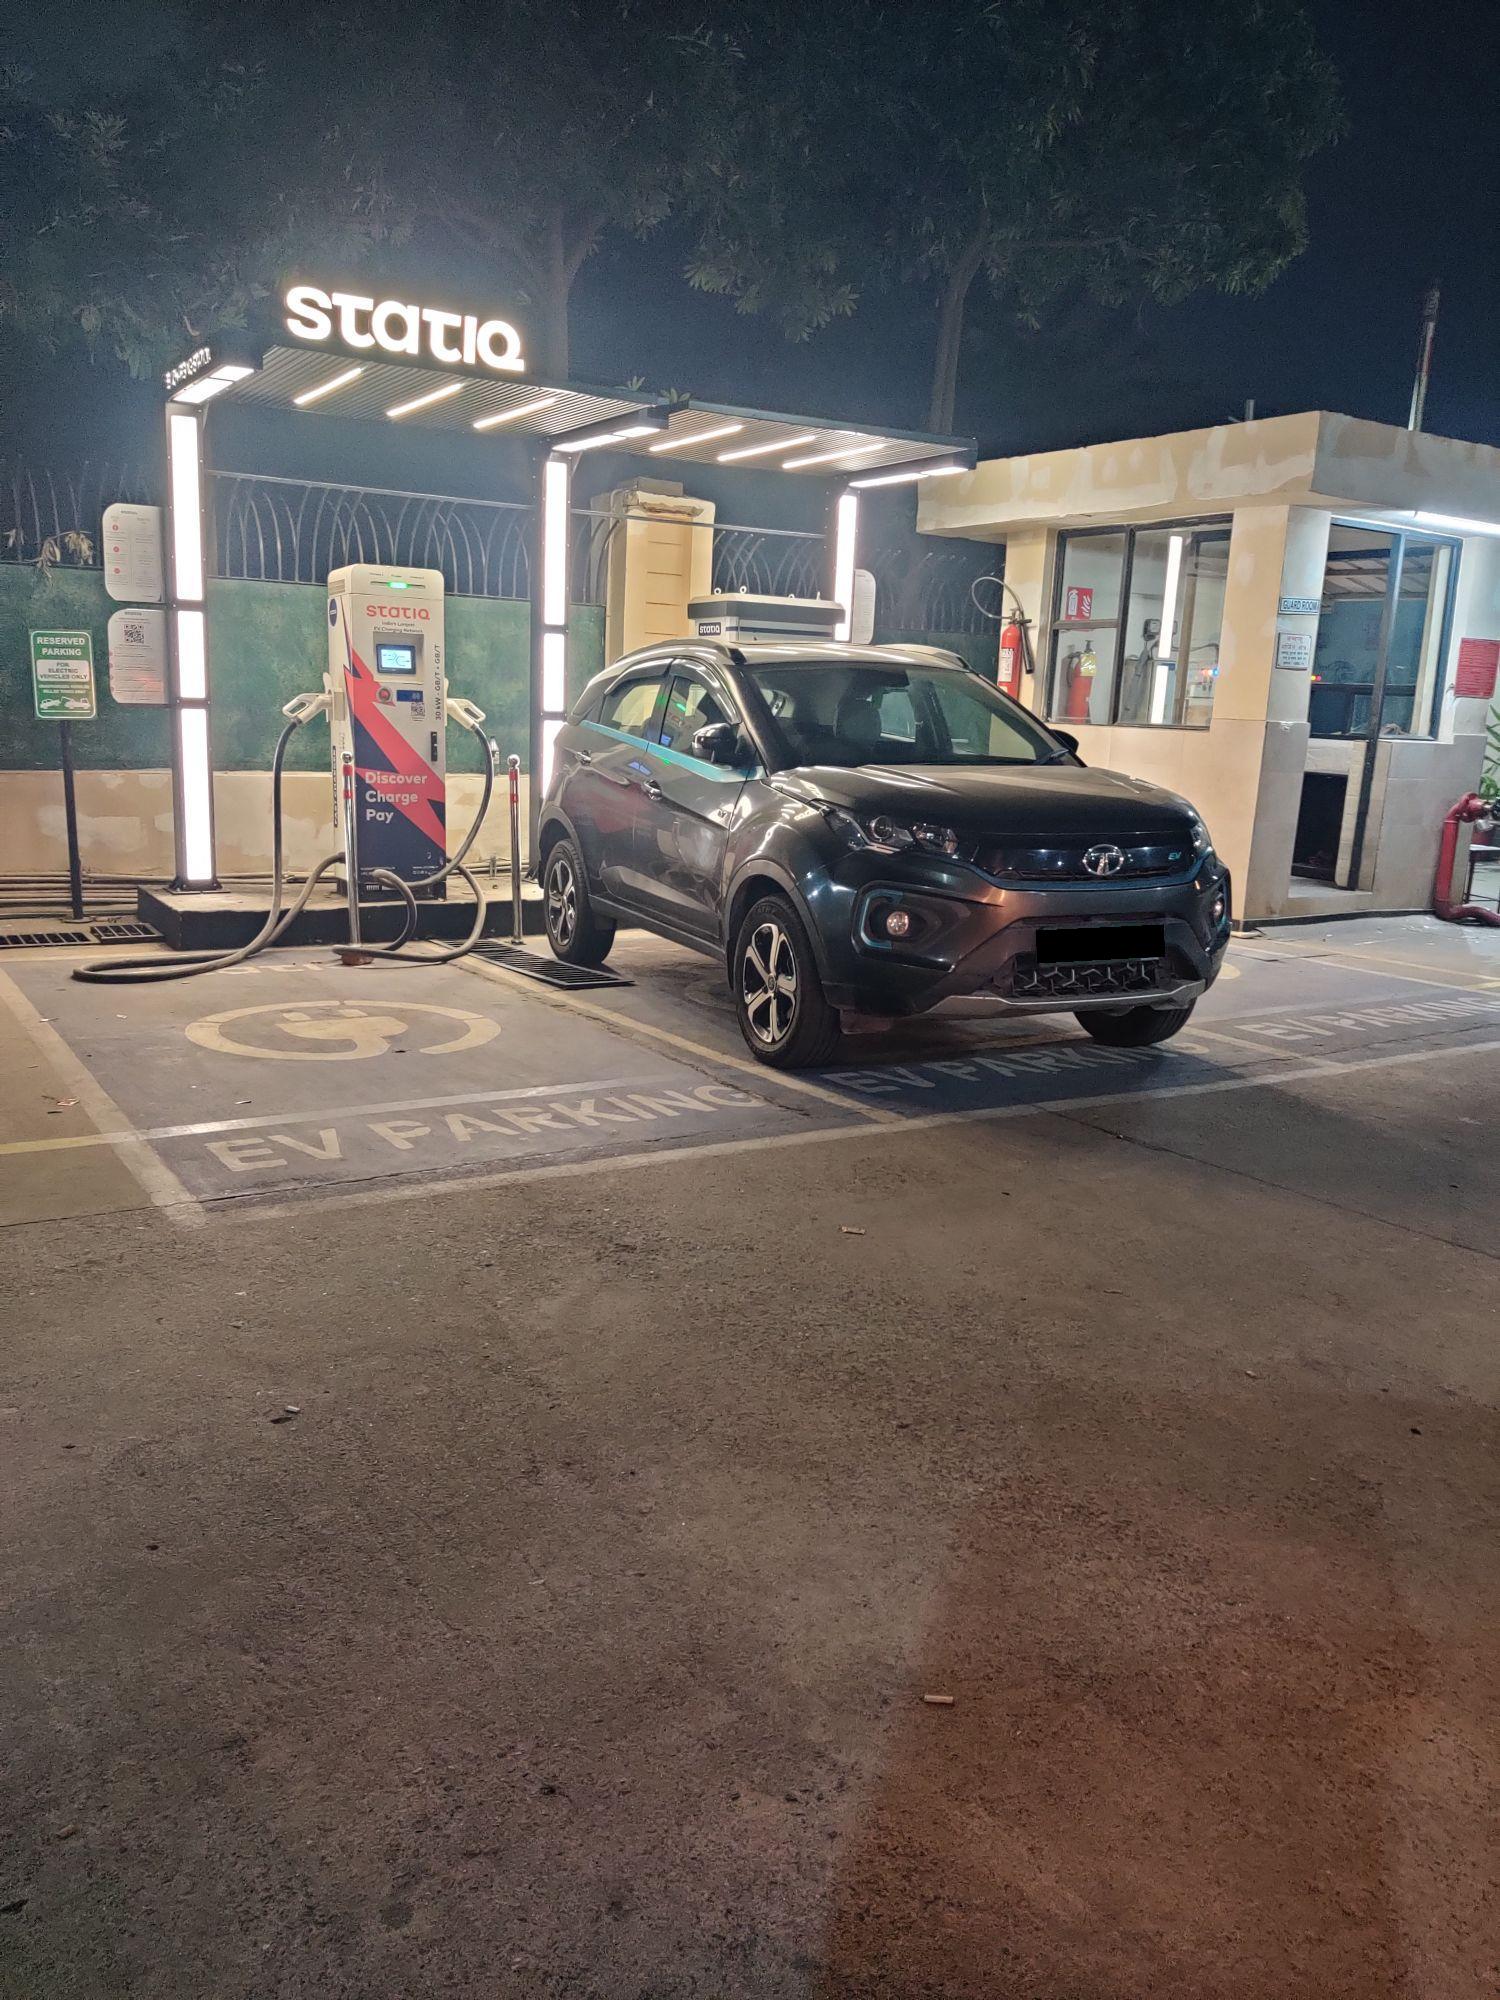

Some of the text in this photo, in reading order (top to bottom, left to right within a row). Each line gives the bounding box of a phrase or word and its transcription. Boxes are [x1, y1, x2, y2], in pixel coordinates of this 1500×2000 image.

[1283, 600, 1317, 611] GUARD ROOM
[37, 636, 85, 645] RESERVED
[42, 648, 82, 656] PARKING
[365, 771, 428, 785] Discover
[365, 790, 418, 805] Charge
[366, 809, 394, 824] Pay
[1233, 1018, 1336, 1041] EV
[820, 1066, 936, 1094] EV
[202, 1084, 767, 1172] EV PARKING
